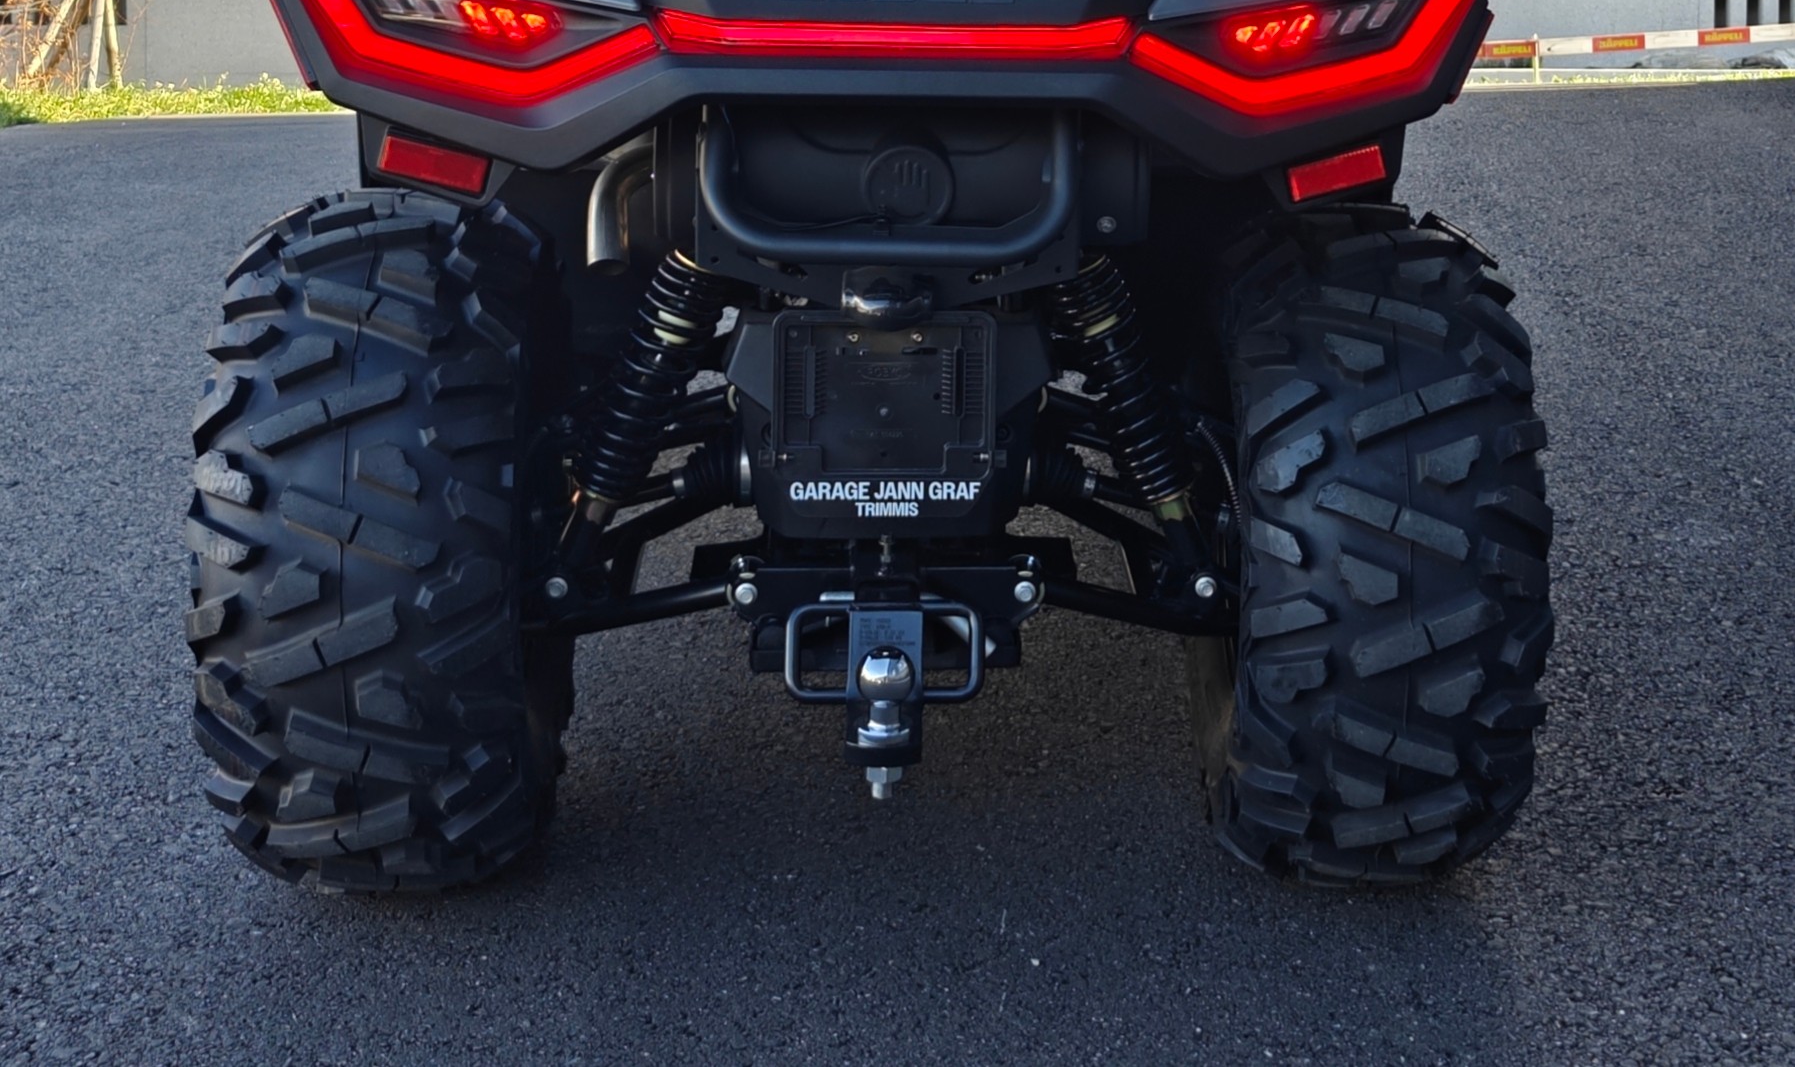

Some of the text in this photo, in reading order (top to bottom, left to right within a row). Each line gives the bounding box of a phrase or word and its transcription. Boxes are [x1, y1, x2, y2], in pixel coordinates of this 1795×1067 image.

[789, 482, 981, 501] GARAGE JANN GRAF
[855, 502, 919, 517] TRIMMIS
